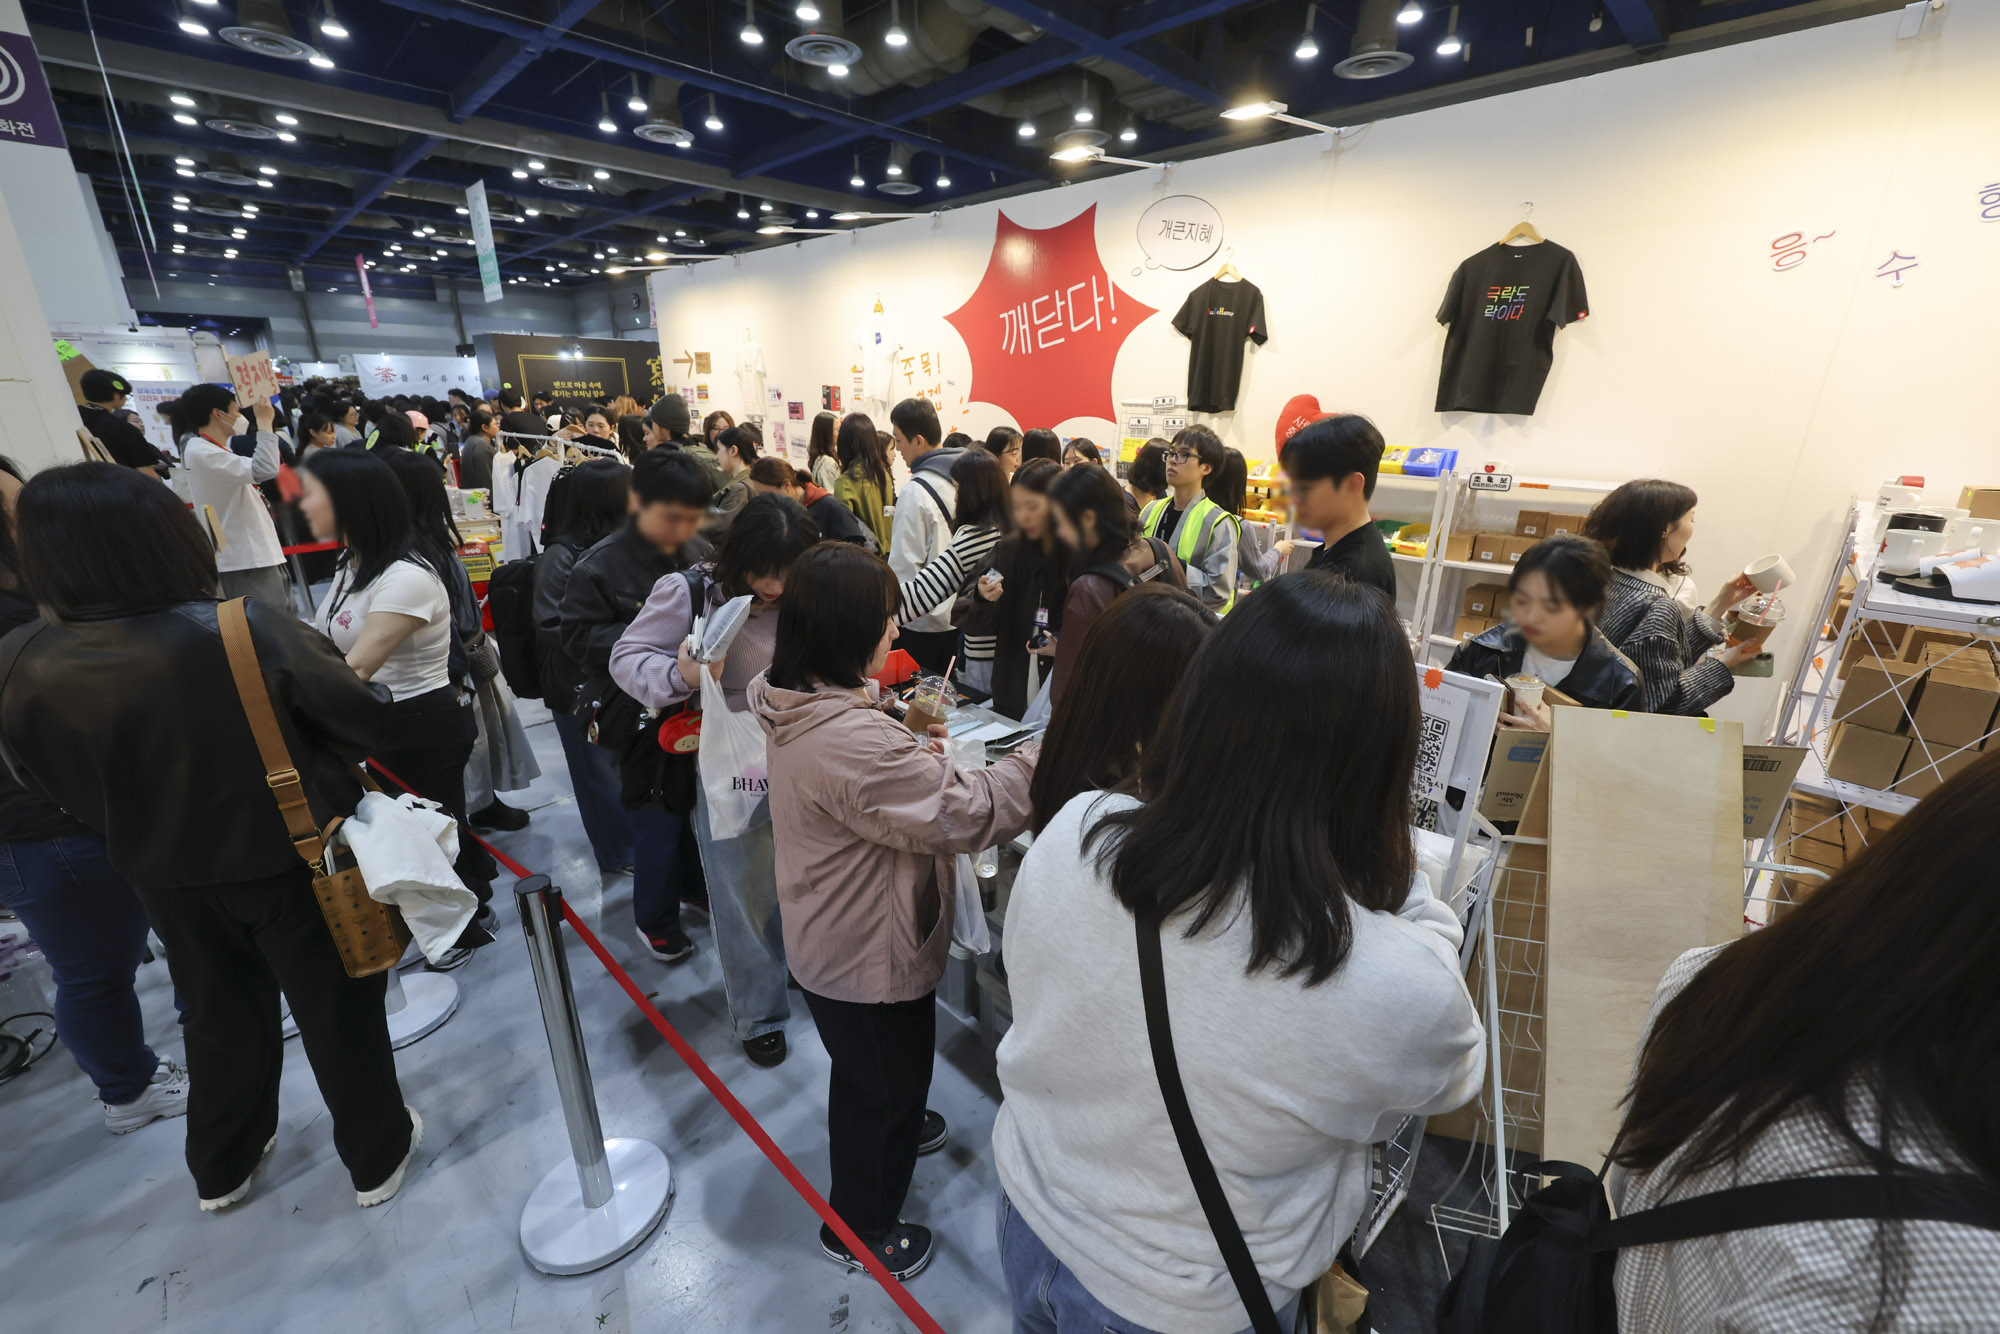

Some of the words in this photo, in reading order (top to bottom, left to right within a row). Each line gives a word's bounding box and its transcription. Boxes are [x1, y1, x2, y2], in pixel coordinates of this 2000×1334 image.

[1158, 219, 1214, 245] 개큰지혜
[1486, 285, 1530, 302] 극락도
[999, 274, 1118, 355] 깨닫다!
[1484, 304, 1525, 321] 락이다
